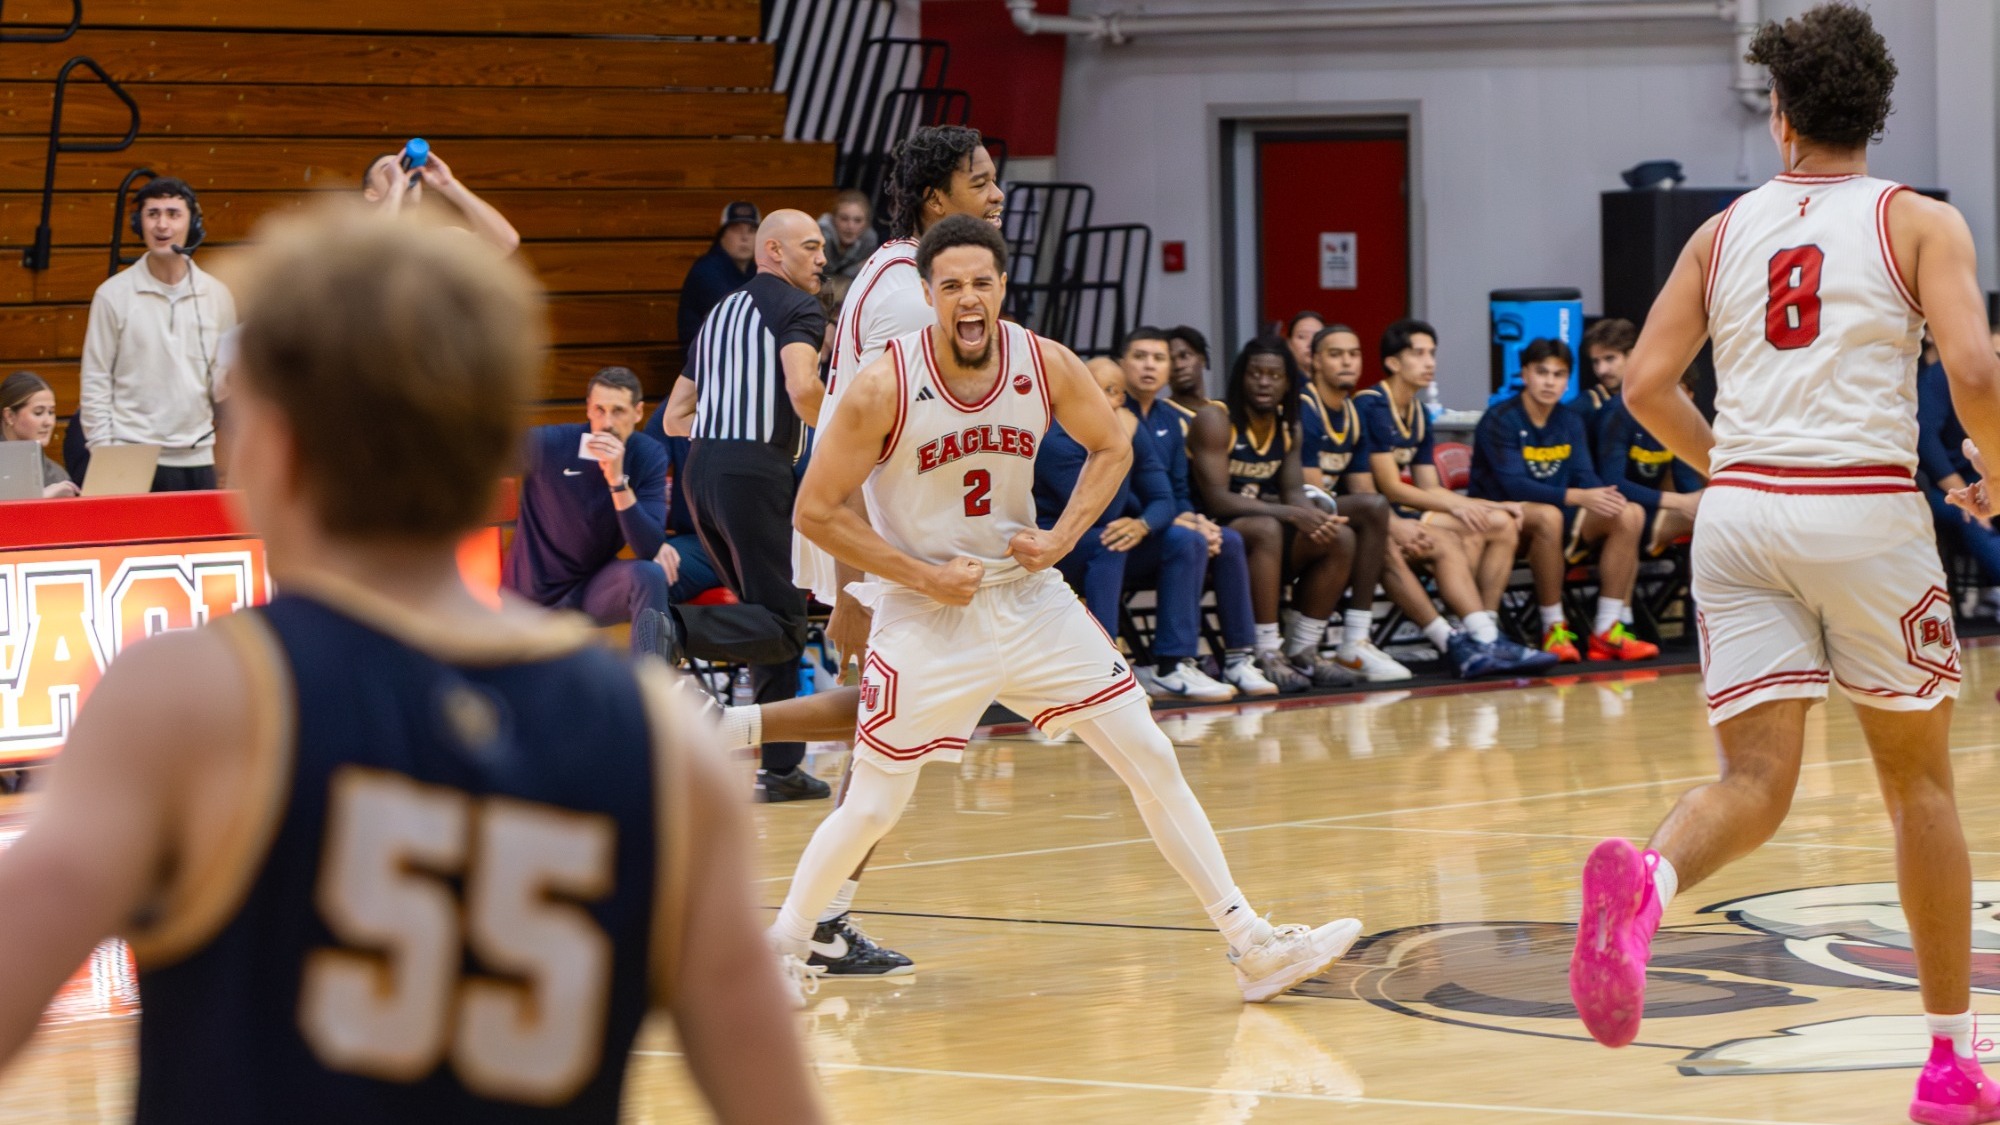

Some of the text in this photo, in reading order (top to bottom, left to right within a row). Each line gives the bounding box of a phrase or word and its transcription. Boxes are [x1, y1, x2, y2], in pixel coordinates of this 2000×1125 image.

[1765, 243, 1825, 350] 8
[917, 425, 1036, 475] EAGLES
[963, 468, 992, 517] 2
[301, 764, 618, 1105] 55
